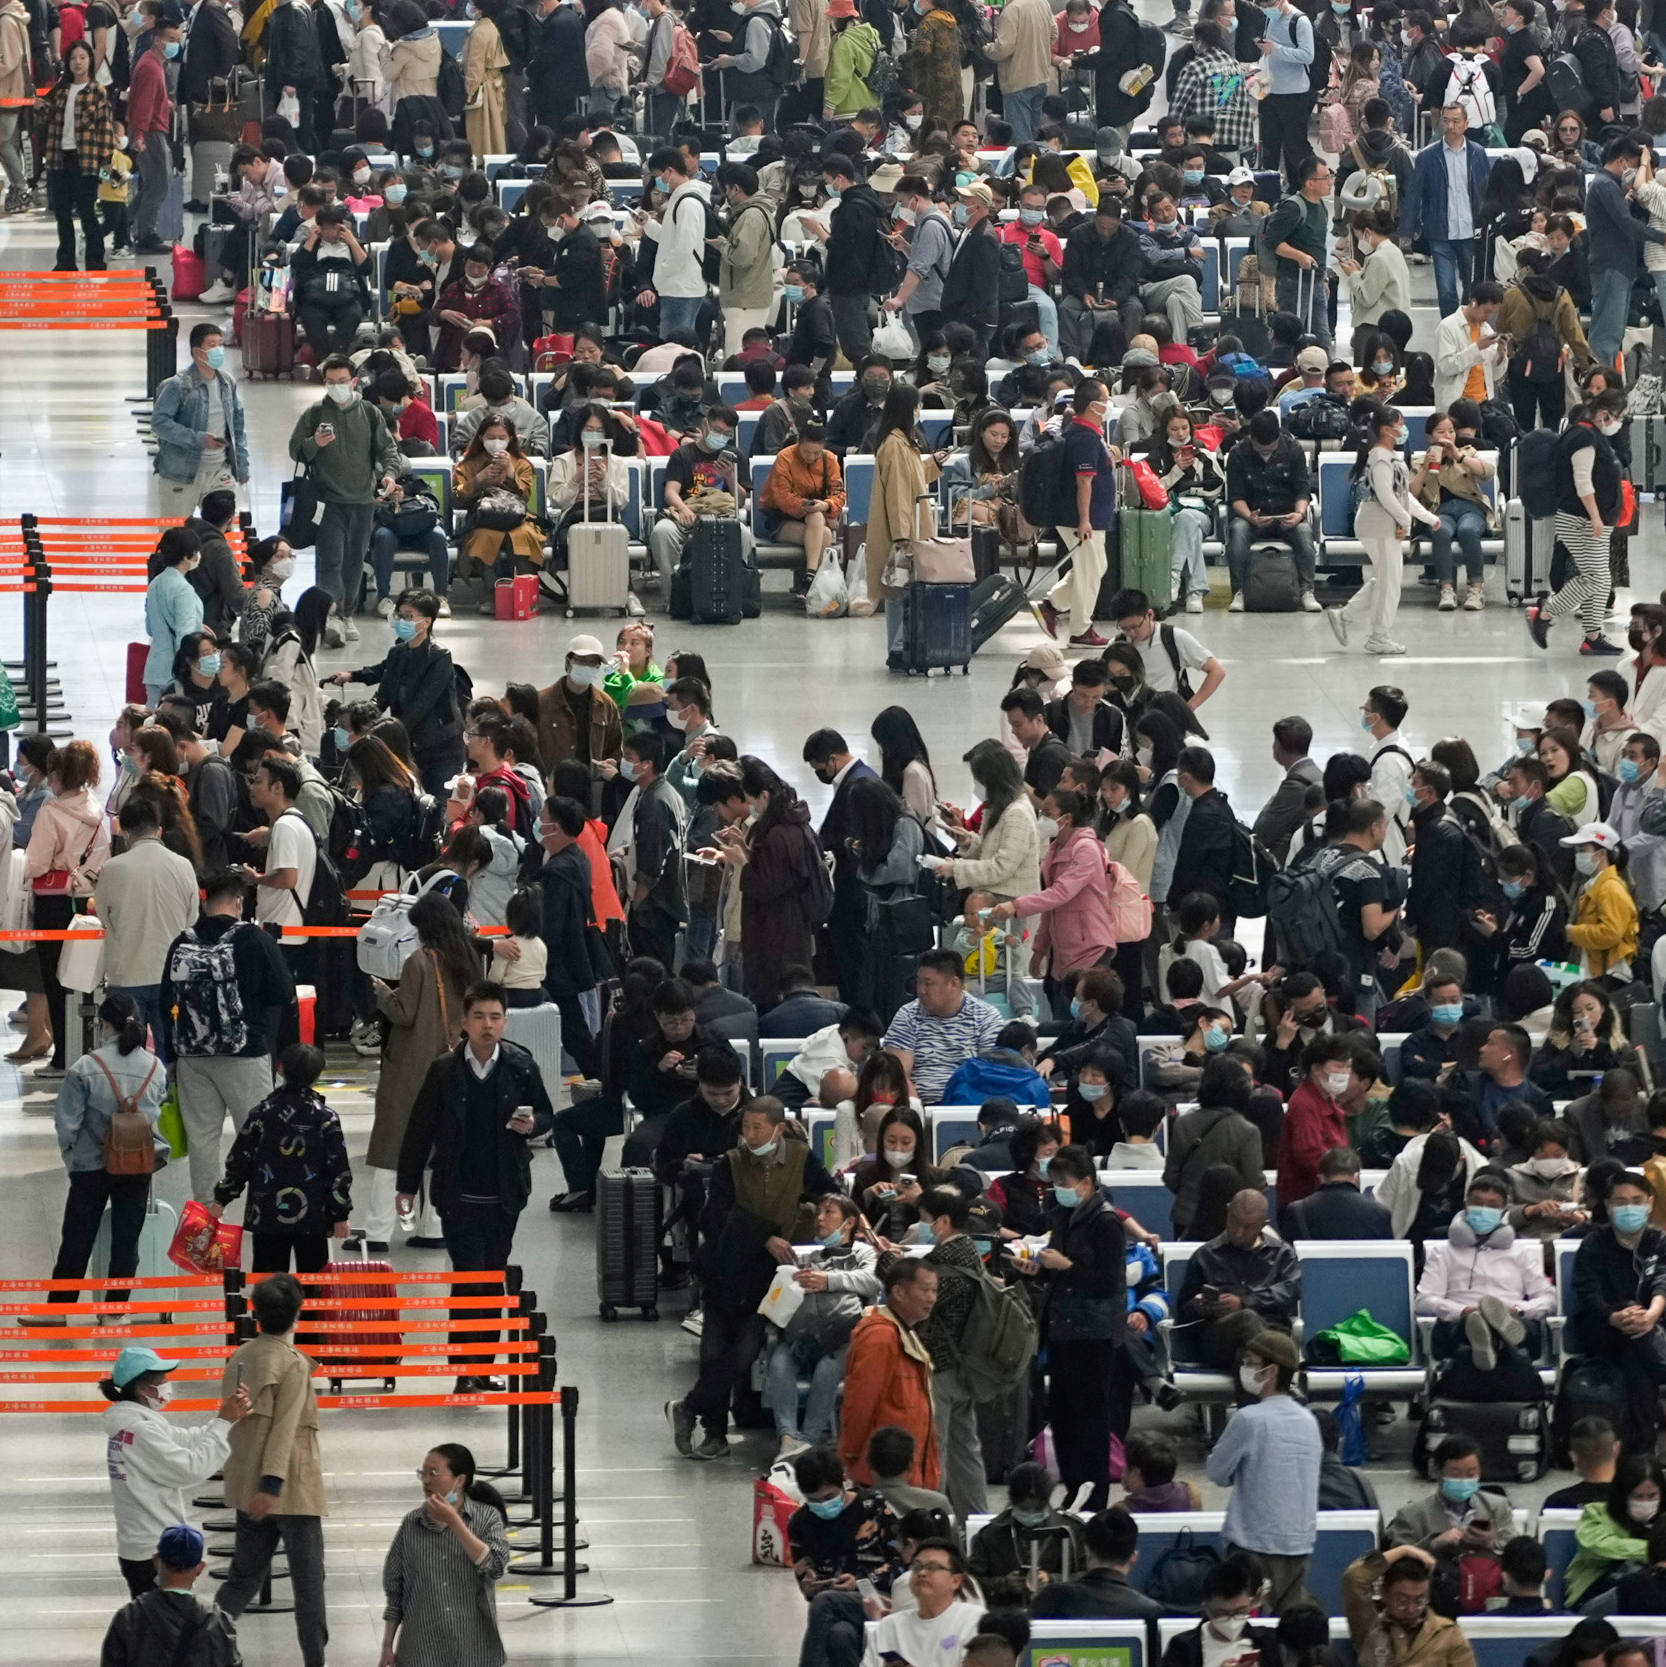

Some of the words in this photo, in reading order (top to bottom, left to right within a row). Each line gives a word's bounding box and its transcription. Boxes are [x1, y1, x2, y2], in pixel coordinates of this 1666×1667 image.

[103, 1278, 142, 1289] 上海虹桥站
[300, 1274, 341, 1284] 上海虹桥站
[401, 1272, 441, 1284] 上海虹桥站
[0, 1280, 41, 1289] 上海虹桥站
[92, 1302, 133, 1313] 上海虹桥站
[303, 1299, 343, 1309] 上海虹桥站
[404, 1297, 445, 1308] 上海虹桥站
[91, 1326, 131, 1337] 上海虹桥站
[194, 1323, 235, 1334] 上海虹桥站
[312, 1321, 353, 1332] 上海虹桥站
[416, 1320, 455, 1332] 上海虹桥站
[319, 1345, 359, 1355] 上海虹桥站
[422, 1343, 462, 1355] 上海虹桥站
[322, 1365, 362, 1376] 上海虹桥站
[426, 1364, 467, 1375] 上海虹桥站
[4, 1401, 45, 1411] 上海虹桥站
